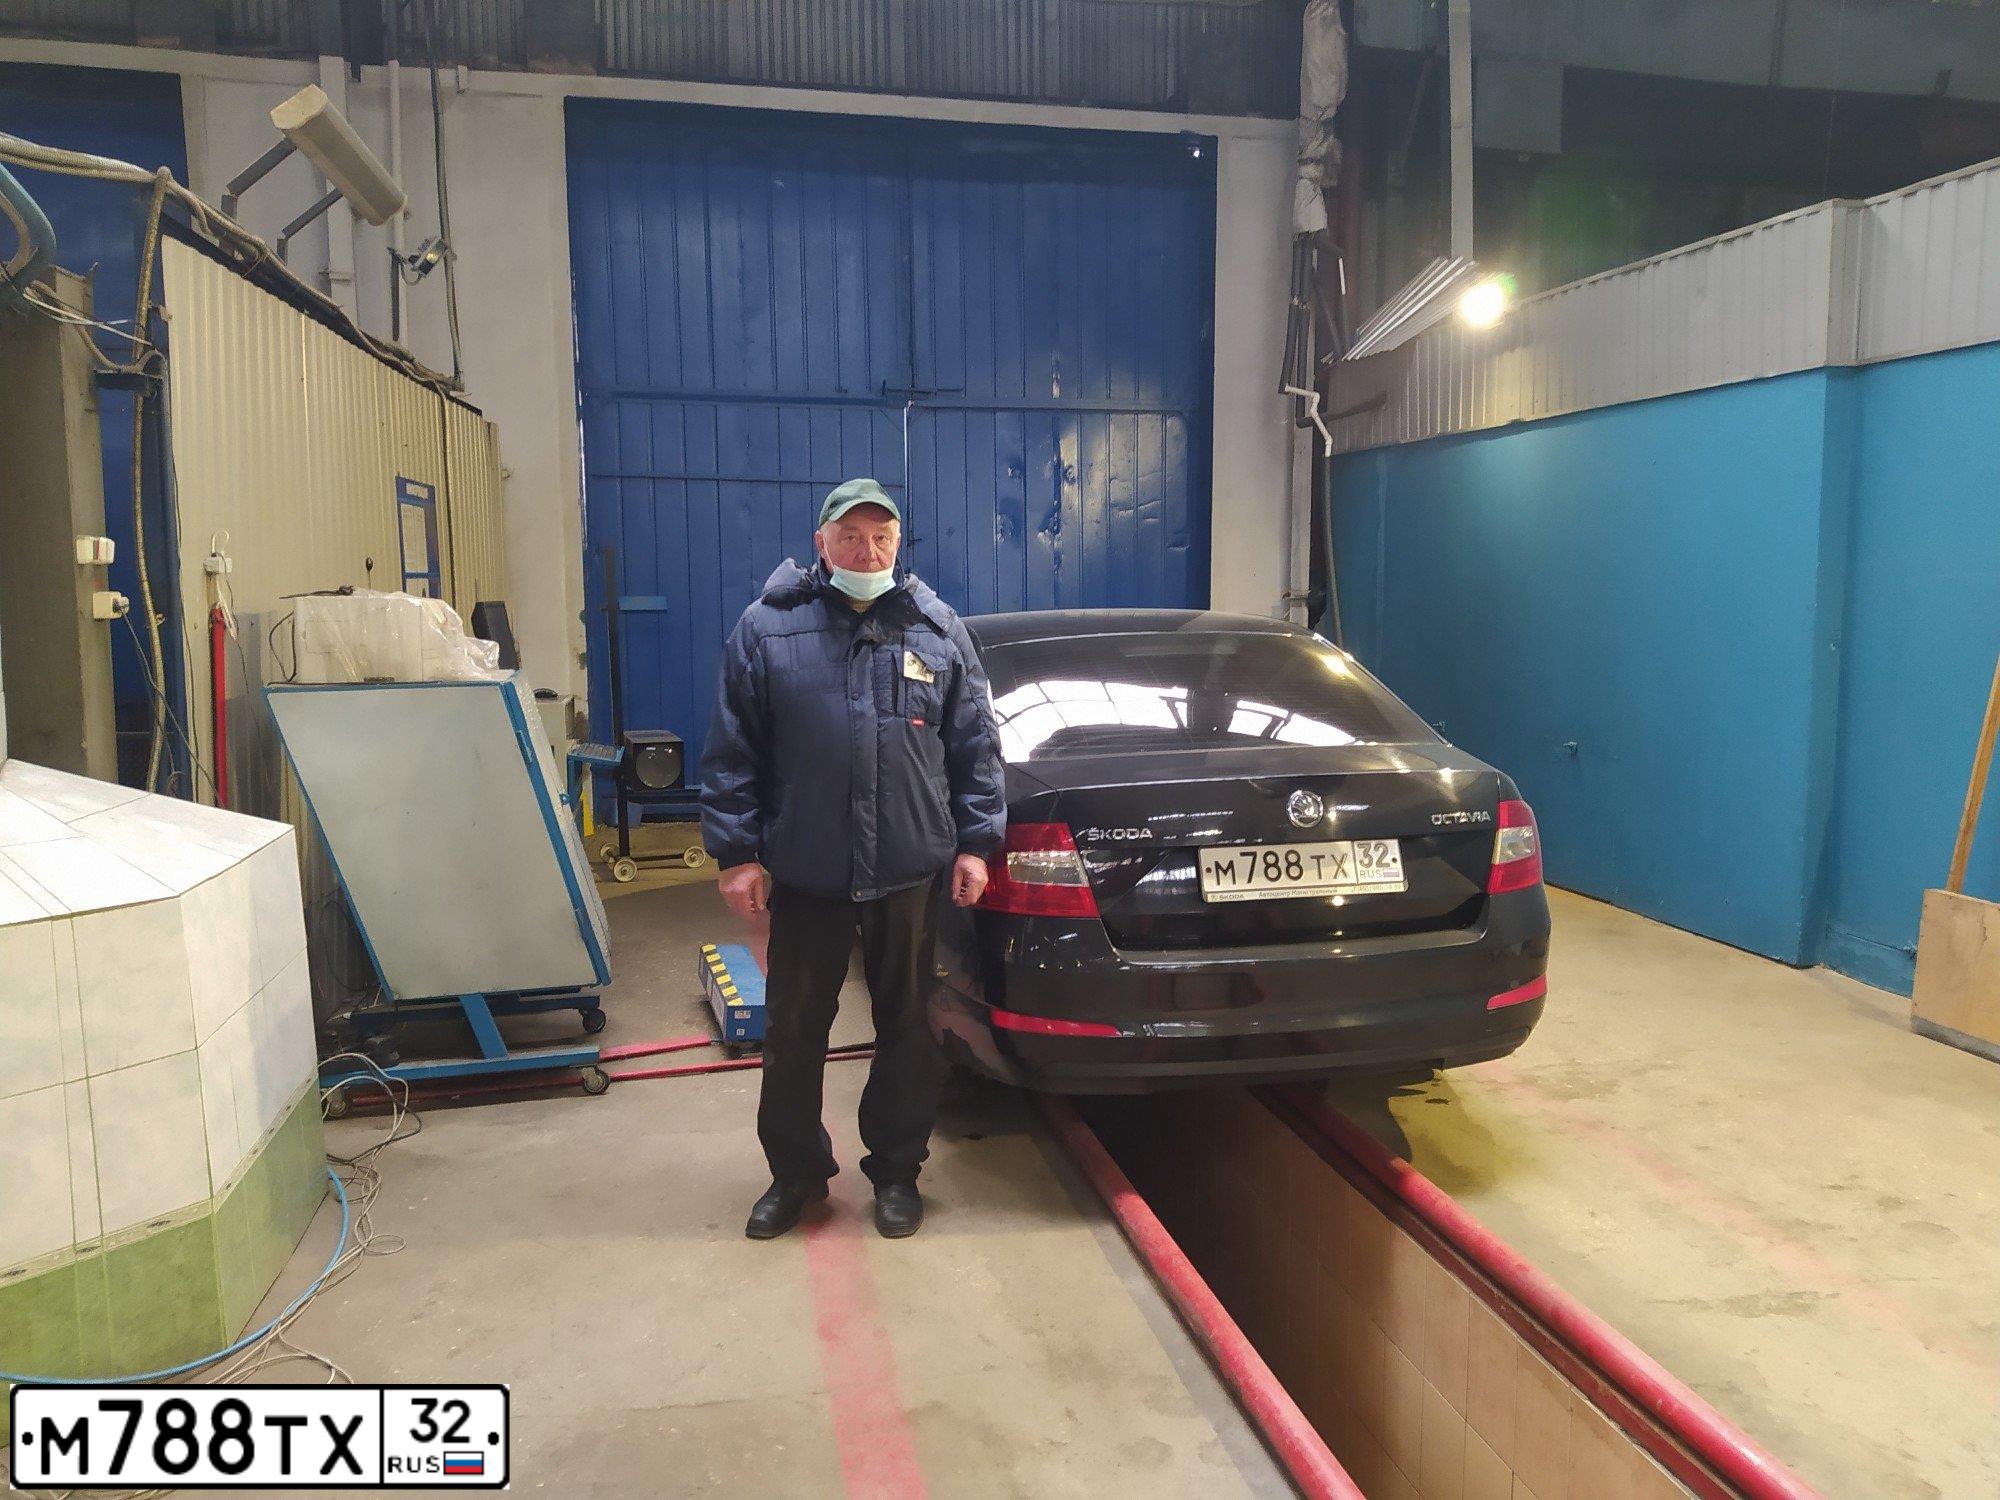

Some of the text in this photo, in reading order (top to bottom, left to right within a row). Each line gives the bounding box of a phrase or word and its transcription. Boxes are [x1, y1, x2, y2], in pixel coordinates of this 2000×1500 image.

[1431, 810, 1491, 826] OCTAVIA
[1214, 842, 1390, 886] М788ТХ 32
[1360, 869, 1382, 879] RUS
